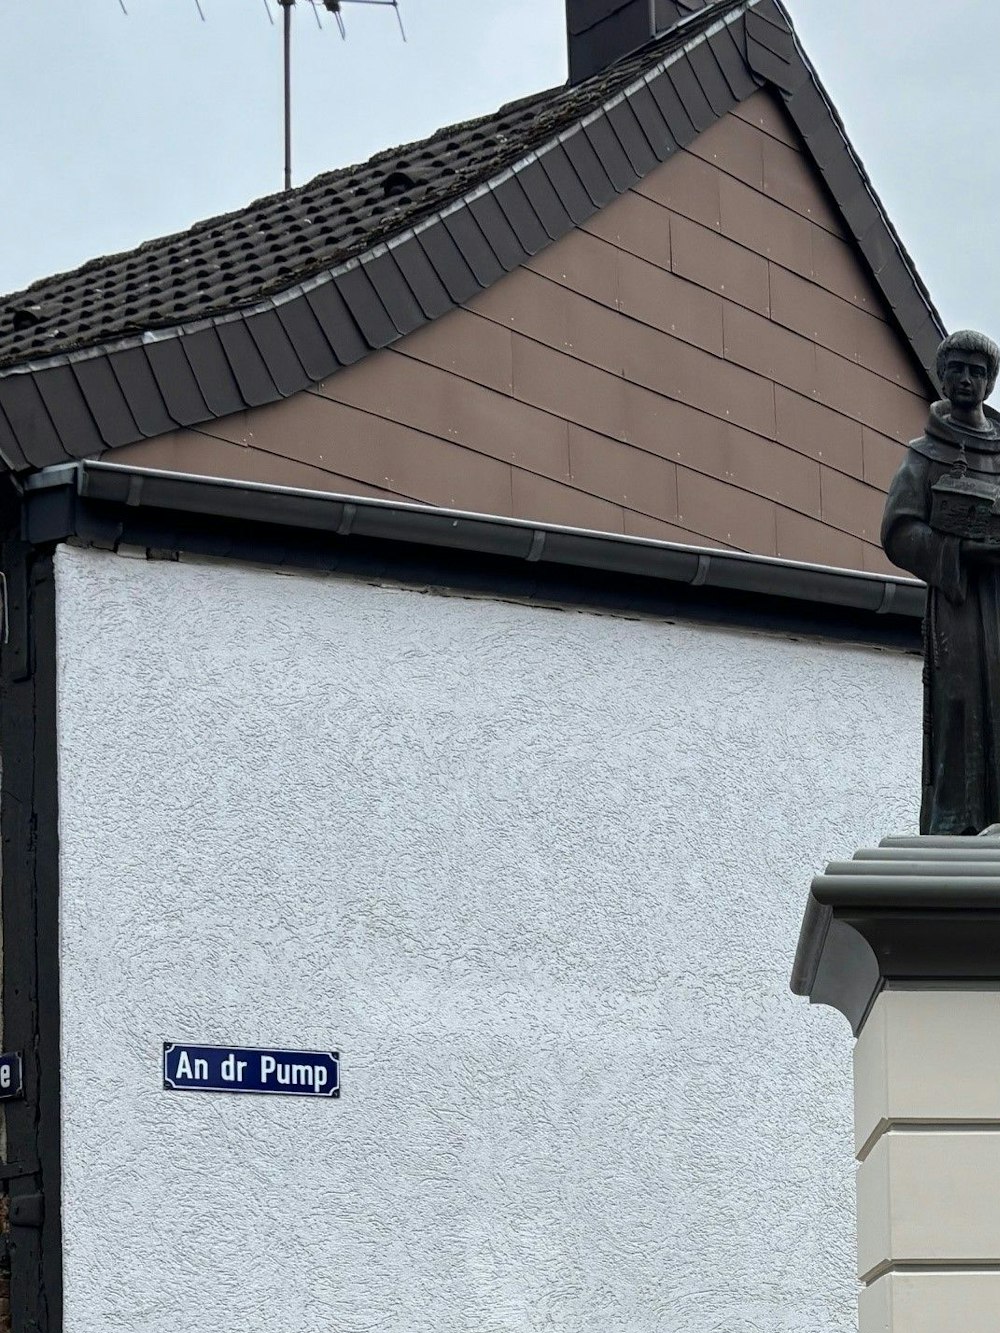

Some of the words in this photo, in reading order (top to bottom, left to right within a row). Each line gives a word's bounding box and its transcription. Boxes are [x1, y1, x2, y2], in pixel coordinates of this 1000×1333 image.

[176, 1050, 208, 1080] An
[221, 1053, 248, 1082] dr
[261, 1055, 328, 1092] Pump
